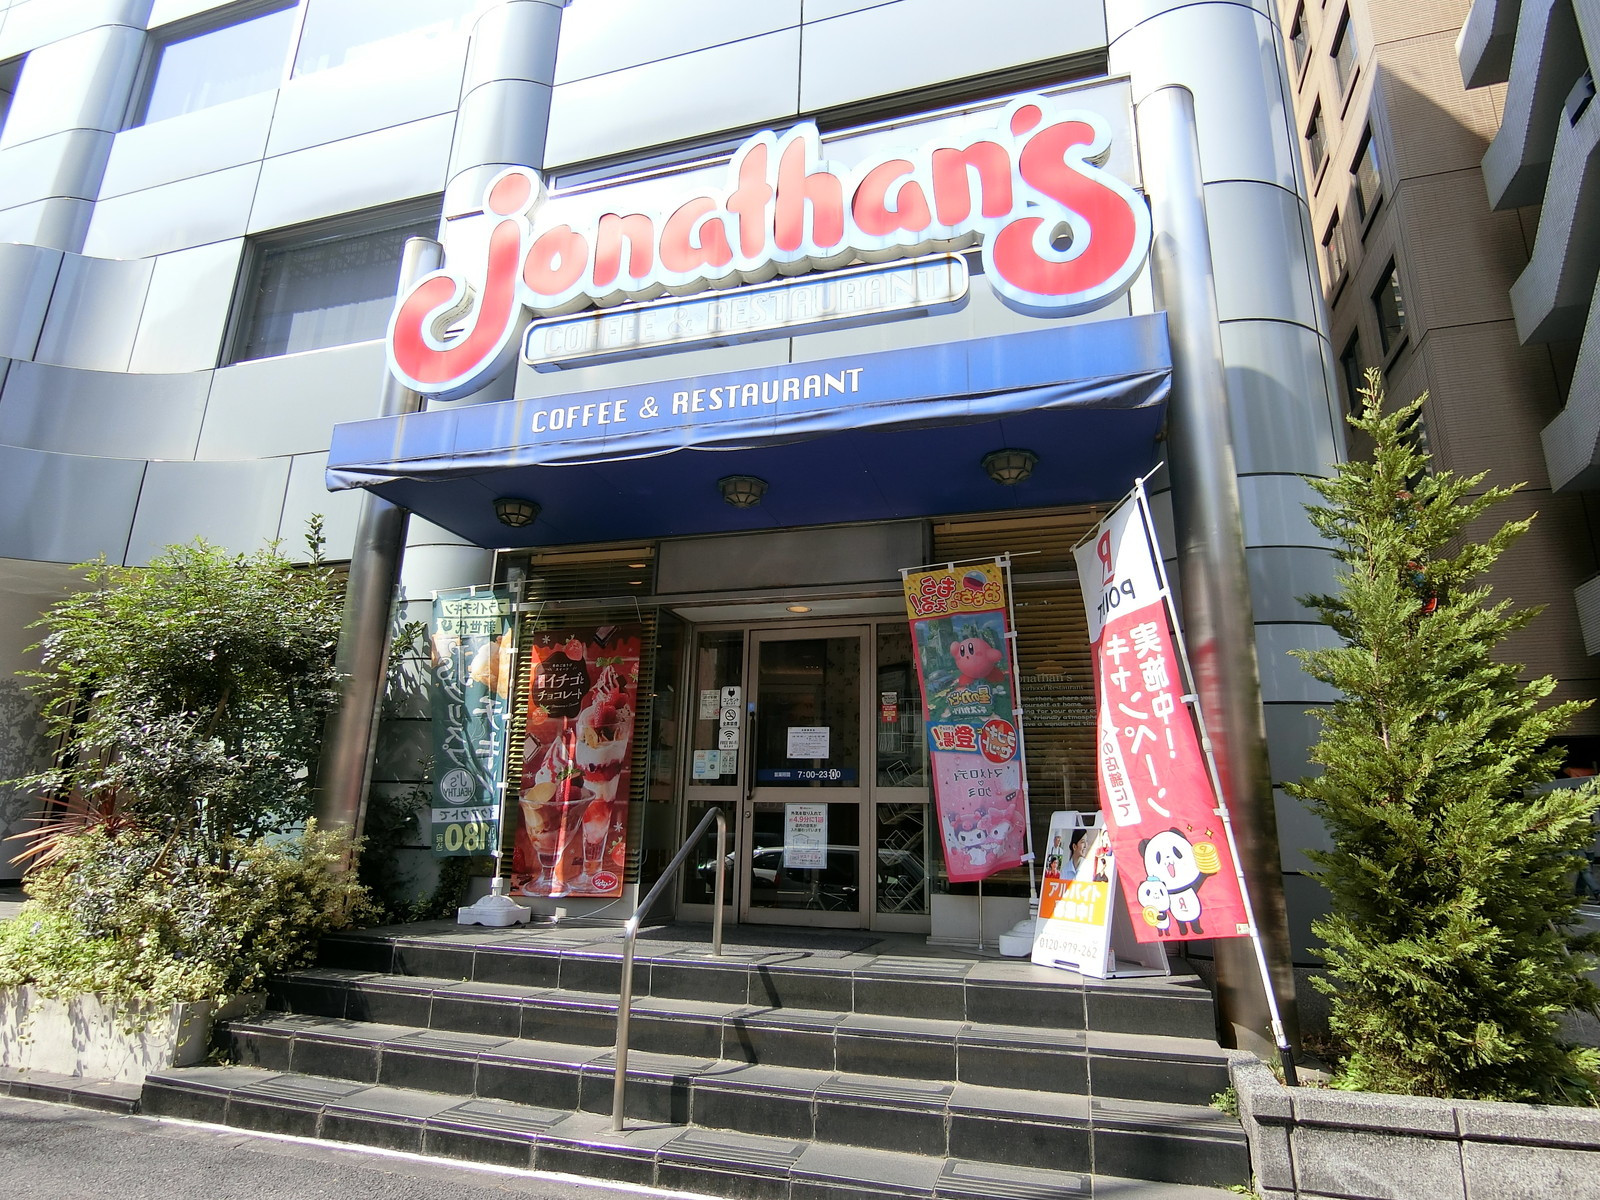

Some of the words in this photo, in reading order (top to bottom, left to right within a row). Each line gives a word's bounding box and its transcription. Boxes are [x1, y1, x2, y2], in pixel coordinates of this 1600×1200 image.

[544, 310, 657, 355] COFFEE
[668, 307, 693, 336] &
[706, 267, 944, 332] RESTAURANT
[531, 399, 628, 434] COFFEE
[638, 396, 660, 419] &
[671, 367, 865, 416] RESTAURANT
[545, 671, 585, 689] イチゴと
[537, 688, 583, 702] チョコレート
[1048, 881, 1102, 903] アルバイト
[1039, 936, 1098, 959] 0120-979-262
